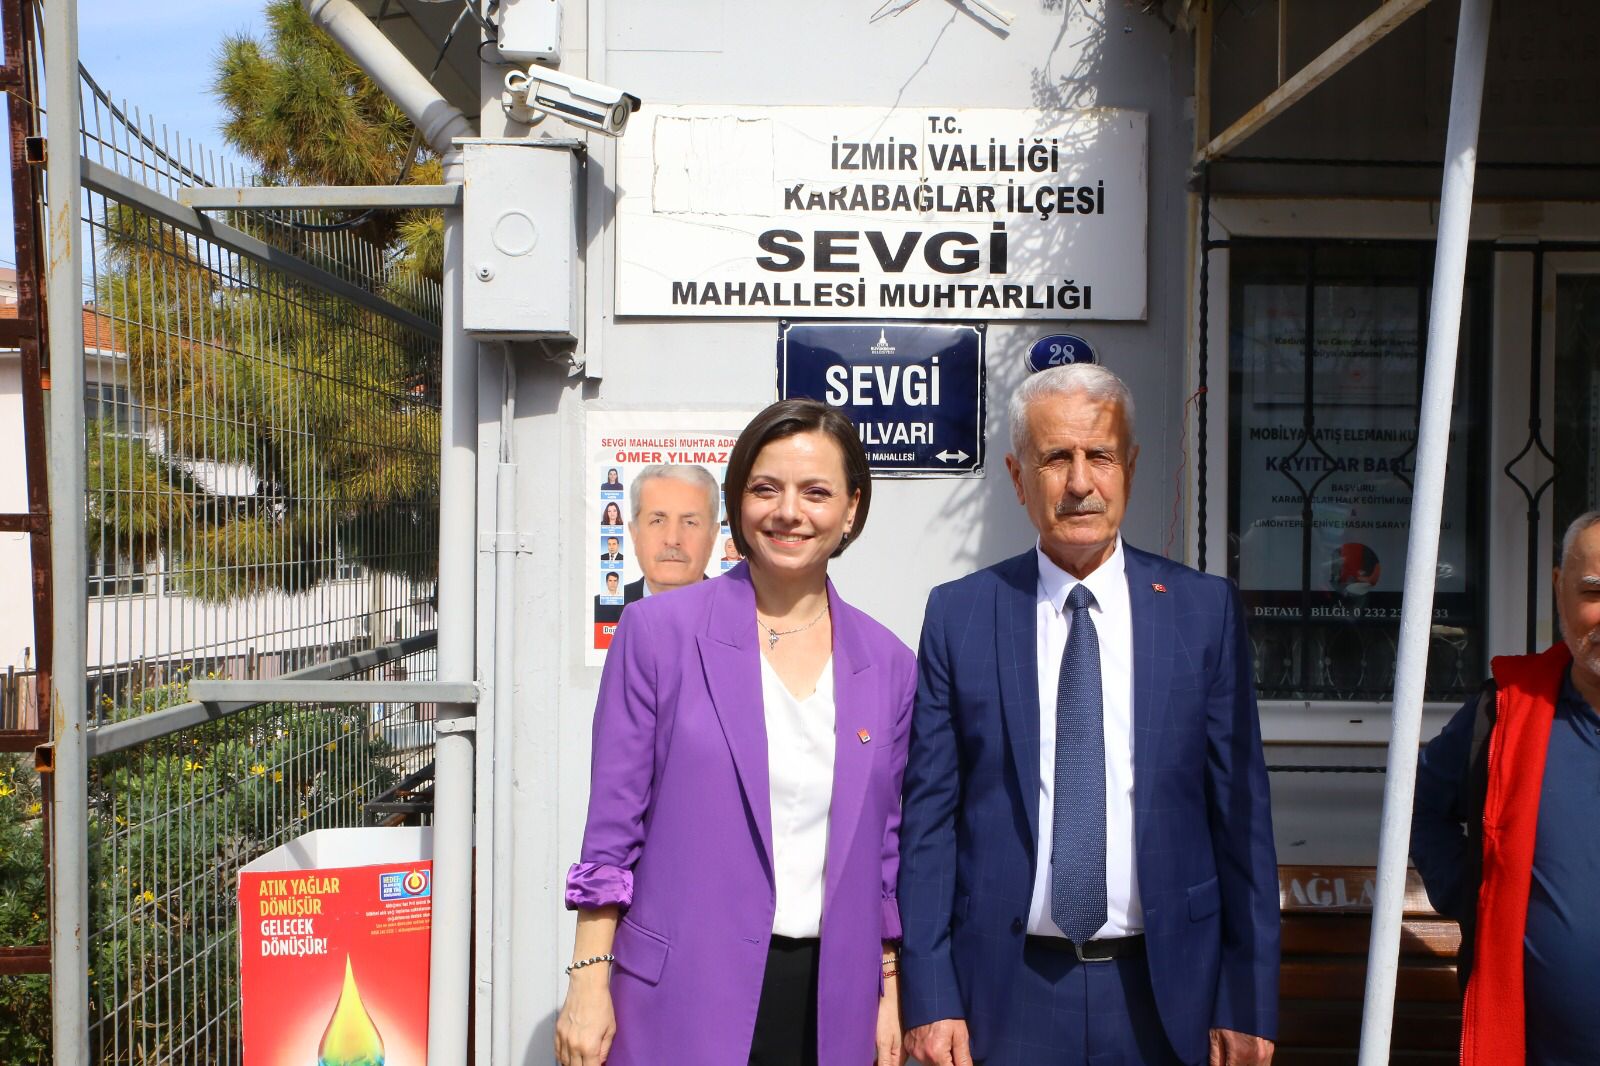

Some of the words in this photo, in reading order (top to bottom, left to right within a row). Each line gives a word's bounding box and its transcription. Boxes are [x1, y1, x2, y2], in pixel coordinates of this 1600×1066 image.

[927, 116, 963, 134] T.C.
[831, 135, 918, 171] İZMİR
[928, 138, 1059, 173] VALİLİĞİ
[784, 177, 996, 214] KARABAĞLAR
[1007, 178, 1105, 222] İLÇESİ
[756, 221, 1008, 275] SEVGİ
[671, 277, 866, 308] MAHALLESİ
[879, 279, 1092, 311] MUHTARLIĞI
[1048, 343, 1075, 365] 28
[825, 356, 940, 407] SEVGİ
[601, 437, 627, 448] SEVGİ
[629, 437, 677, 448] MAHALLESİ
[680, 438, 715, 448] MUHTAR
[718, 438, 737, 448] ADA
[851, 422, 934, 445] ULVARI
[1250, 424, 1304, 441] MOBİLYA
[1309, 428, 1341, 444] ATIŞ
[1344, 428, 1397, 442] ELEMANI
[615, 450, 662, 463] ÖMER
[667, 451, 728, 464] YILMAZ
[872, 451, 915, 461] MAHALLESİ
[1265, 456, 1359, 473] KAYITLAR
[1254, 607, 1303, 617] DETAYL
[1364, 607, 1386, 617] 232
[259, 879, 288, 897] ATIK
[290, 875, 340, 896] YAĞLAR
[260, 896, 322, 918] DÖNÜŞÜR
[261, 918, 314, 937] GELECEK
[261, 937, 328, 958] DÖNÜŞÜR!
